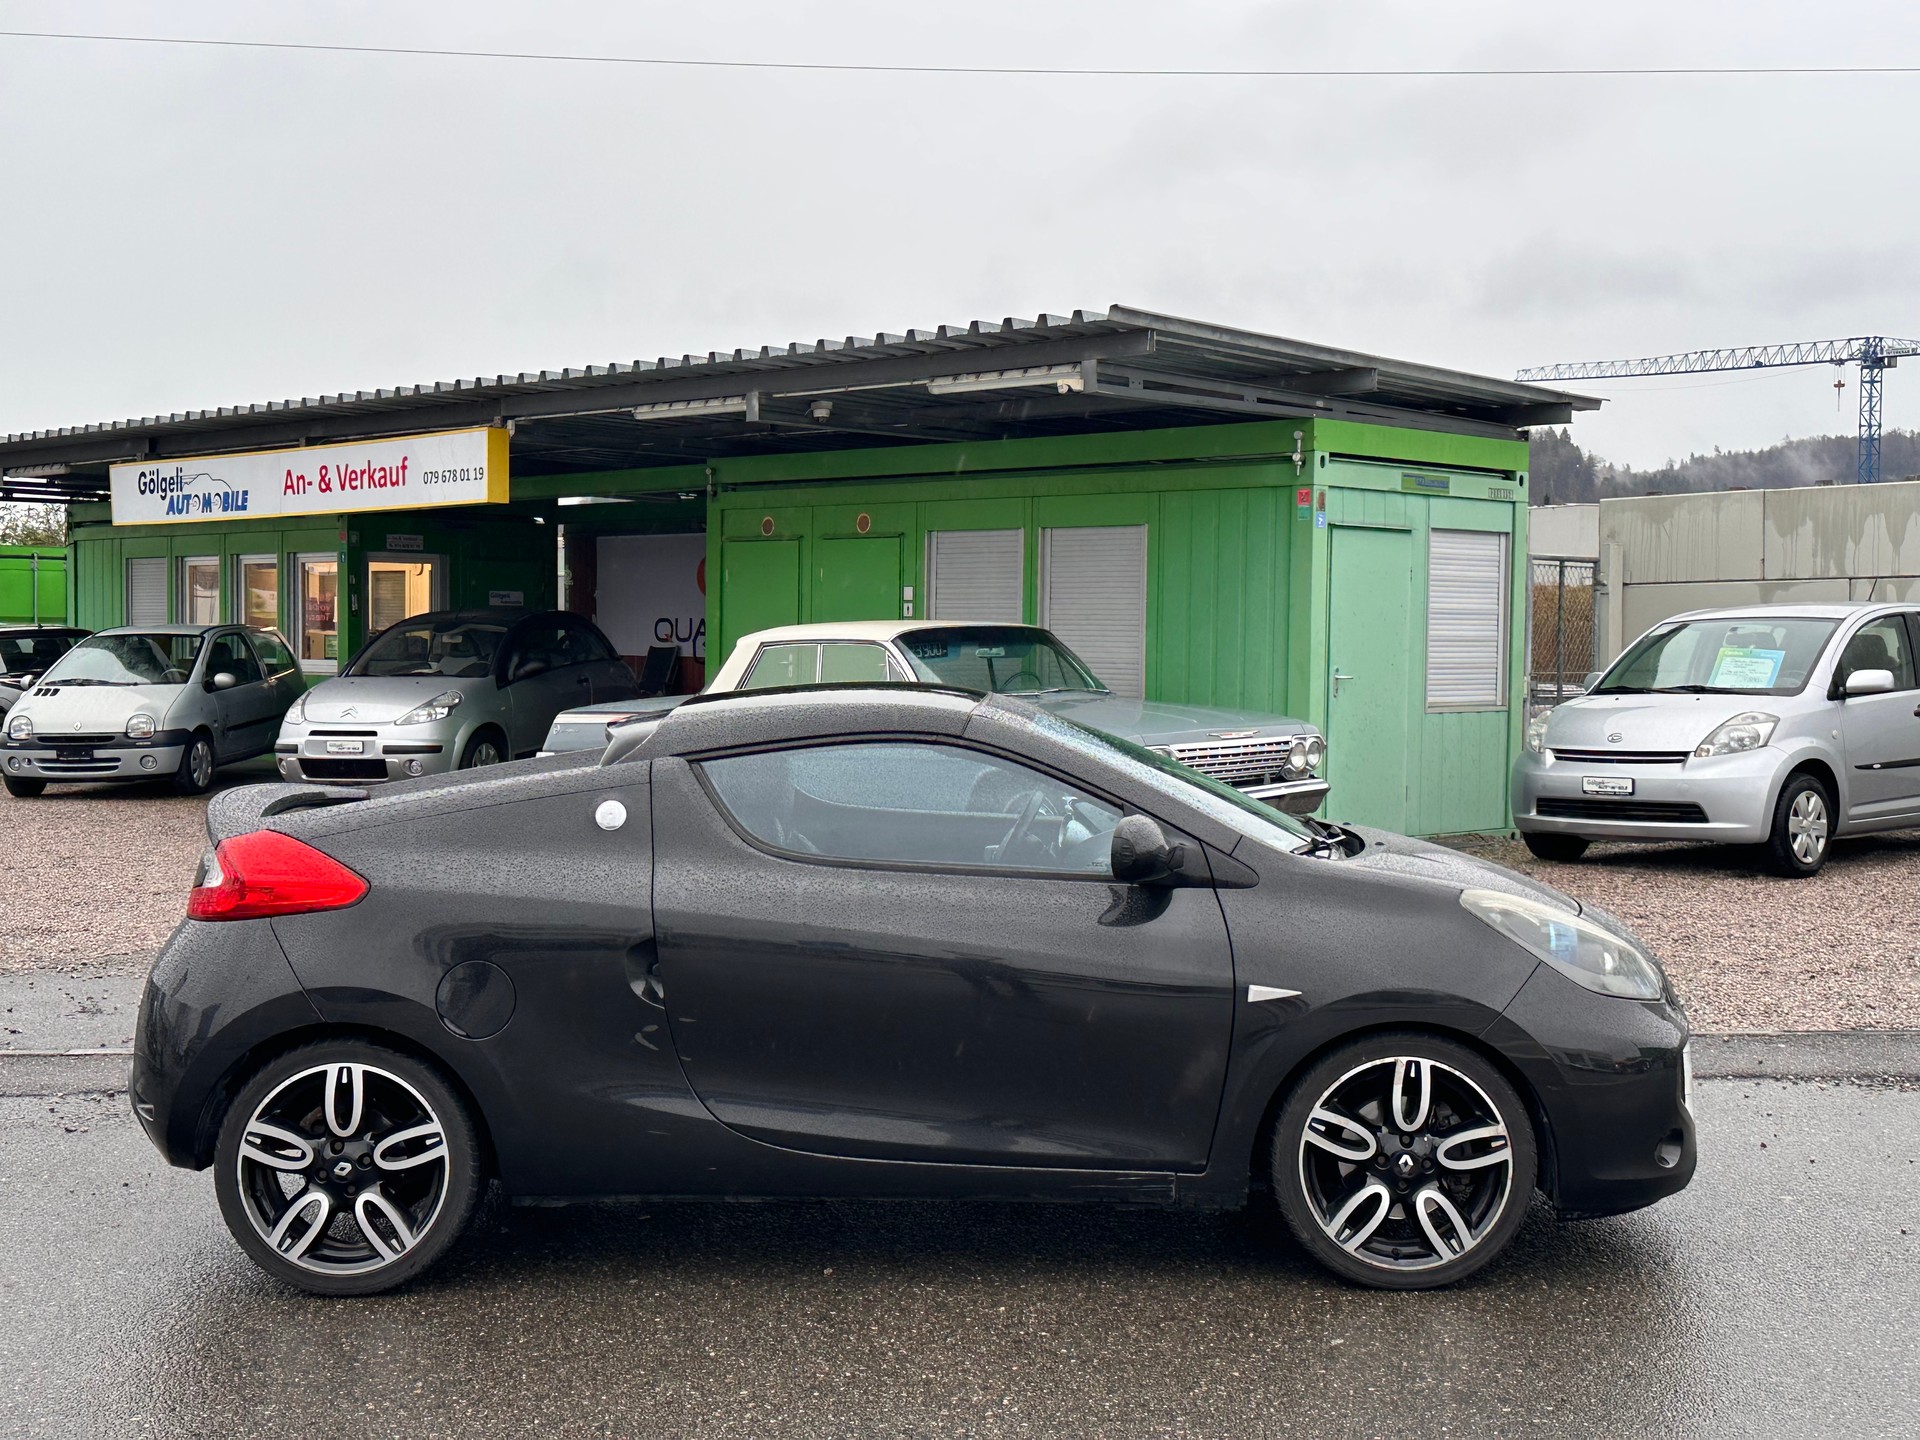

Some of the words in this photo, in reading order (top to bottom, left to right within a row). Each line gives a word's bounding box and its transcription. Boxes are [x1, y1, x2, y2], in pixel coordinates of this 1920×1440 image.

[138, 467, 183, 501] Gölgeli
[284, 469, 313, 496] An-
[318, 464, 332, 493] &
[336, 456, 408, 491] Verkauf
[423, 470, 440, 485] 079
[442, 468, 458, 483] 678
[459, 467, 471, 482] 01
[473, 466, 484, 481] 19
